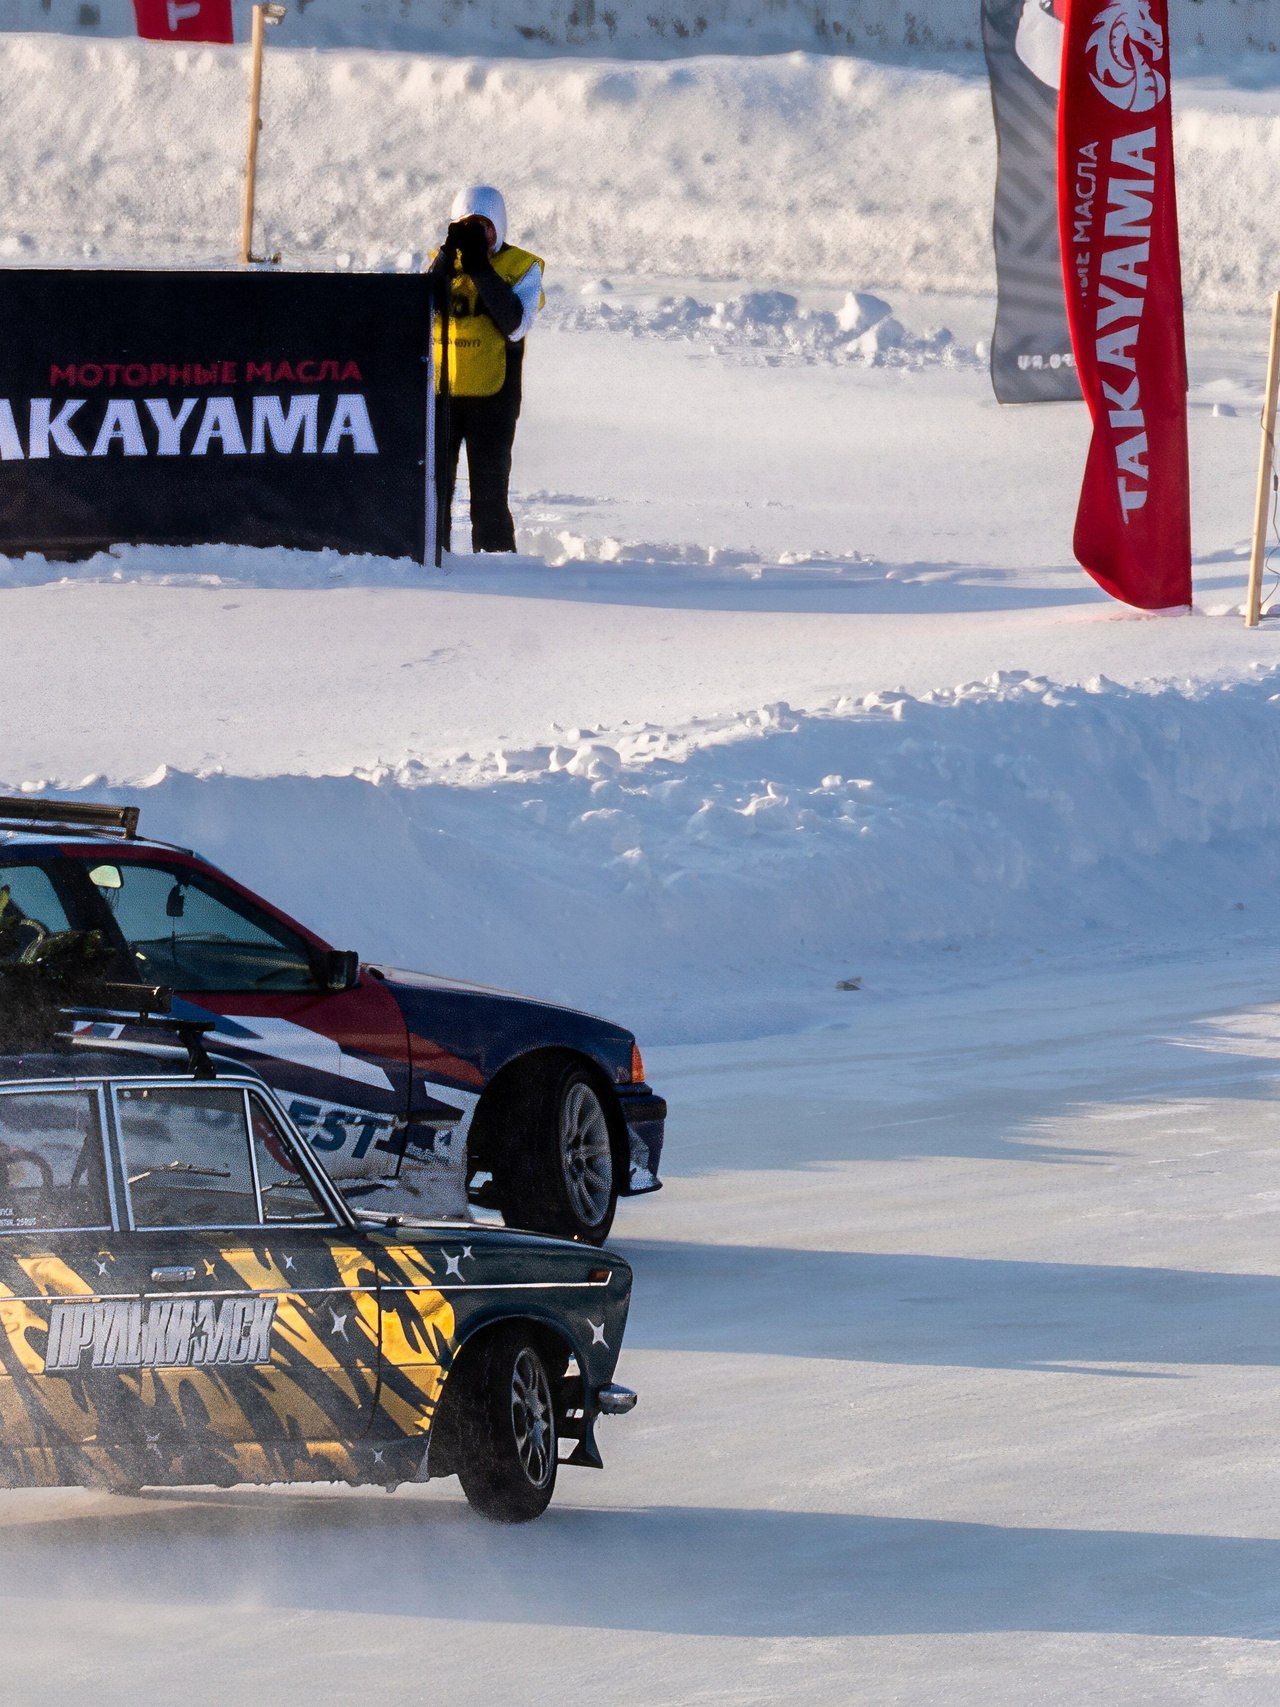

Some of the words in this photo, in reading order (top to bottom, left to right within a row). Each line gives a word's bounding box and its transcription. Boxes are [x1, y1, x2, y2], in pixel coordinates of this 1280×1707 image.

[1072, 141, 1099, 243] МАСЛА
[50, 361, 237, 387] МОТОРНЫЕ
[246, 360, 362, 384] МАСЛА
[1095, 126, 1157, 525] TAKAYAMA
